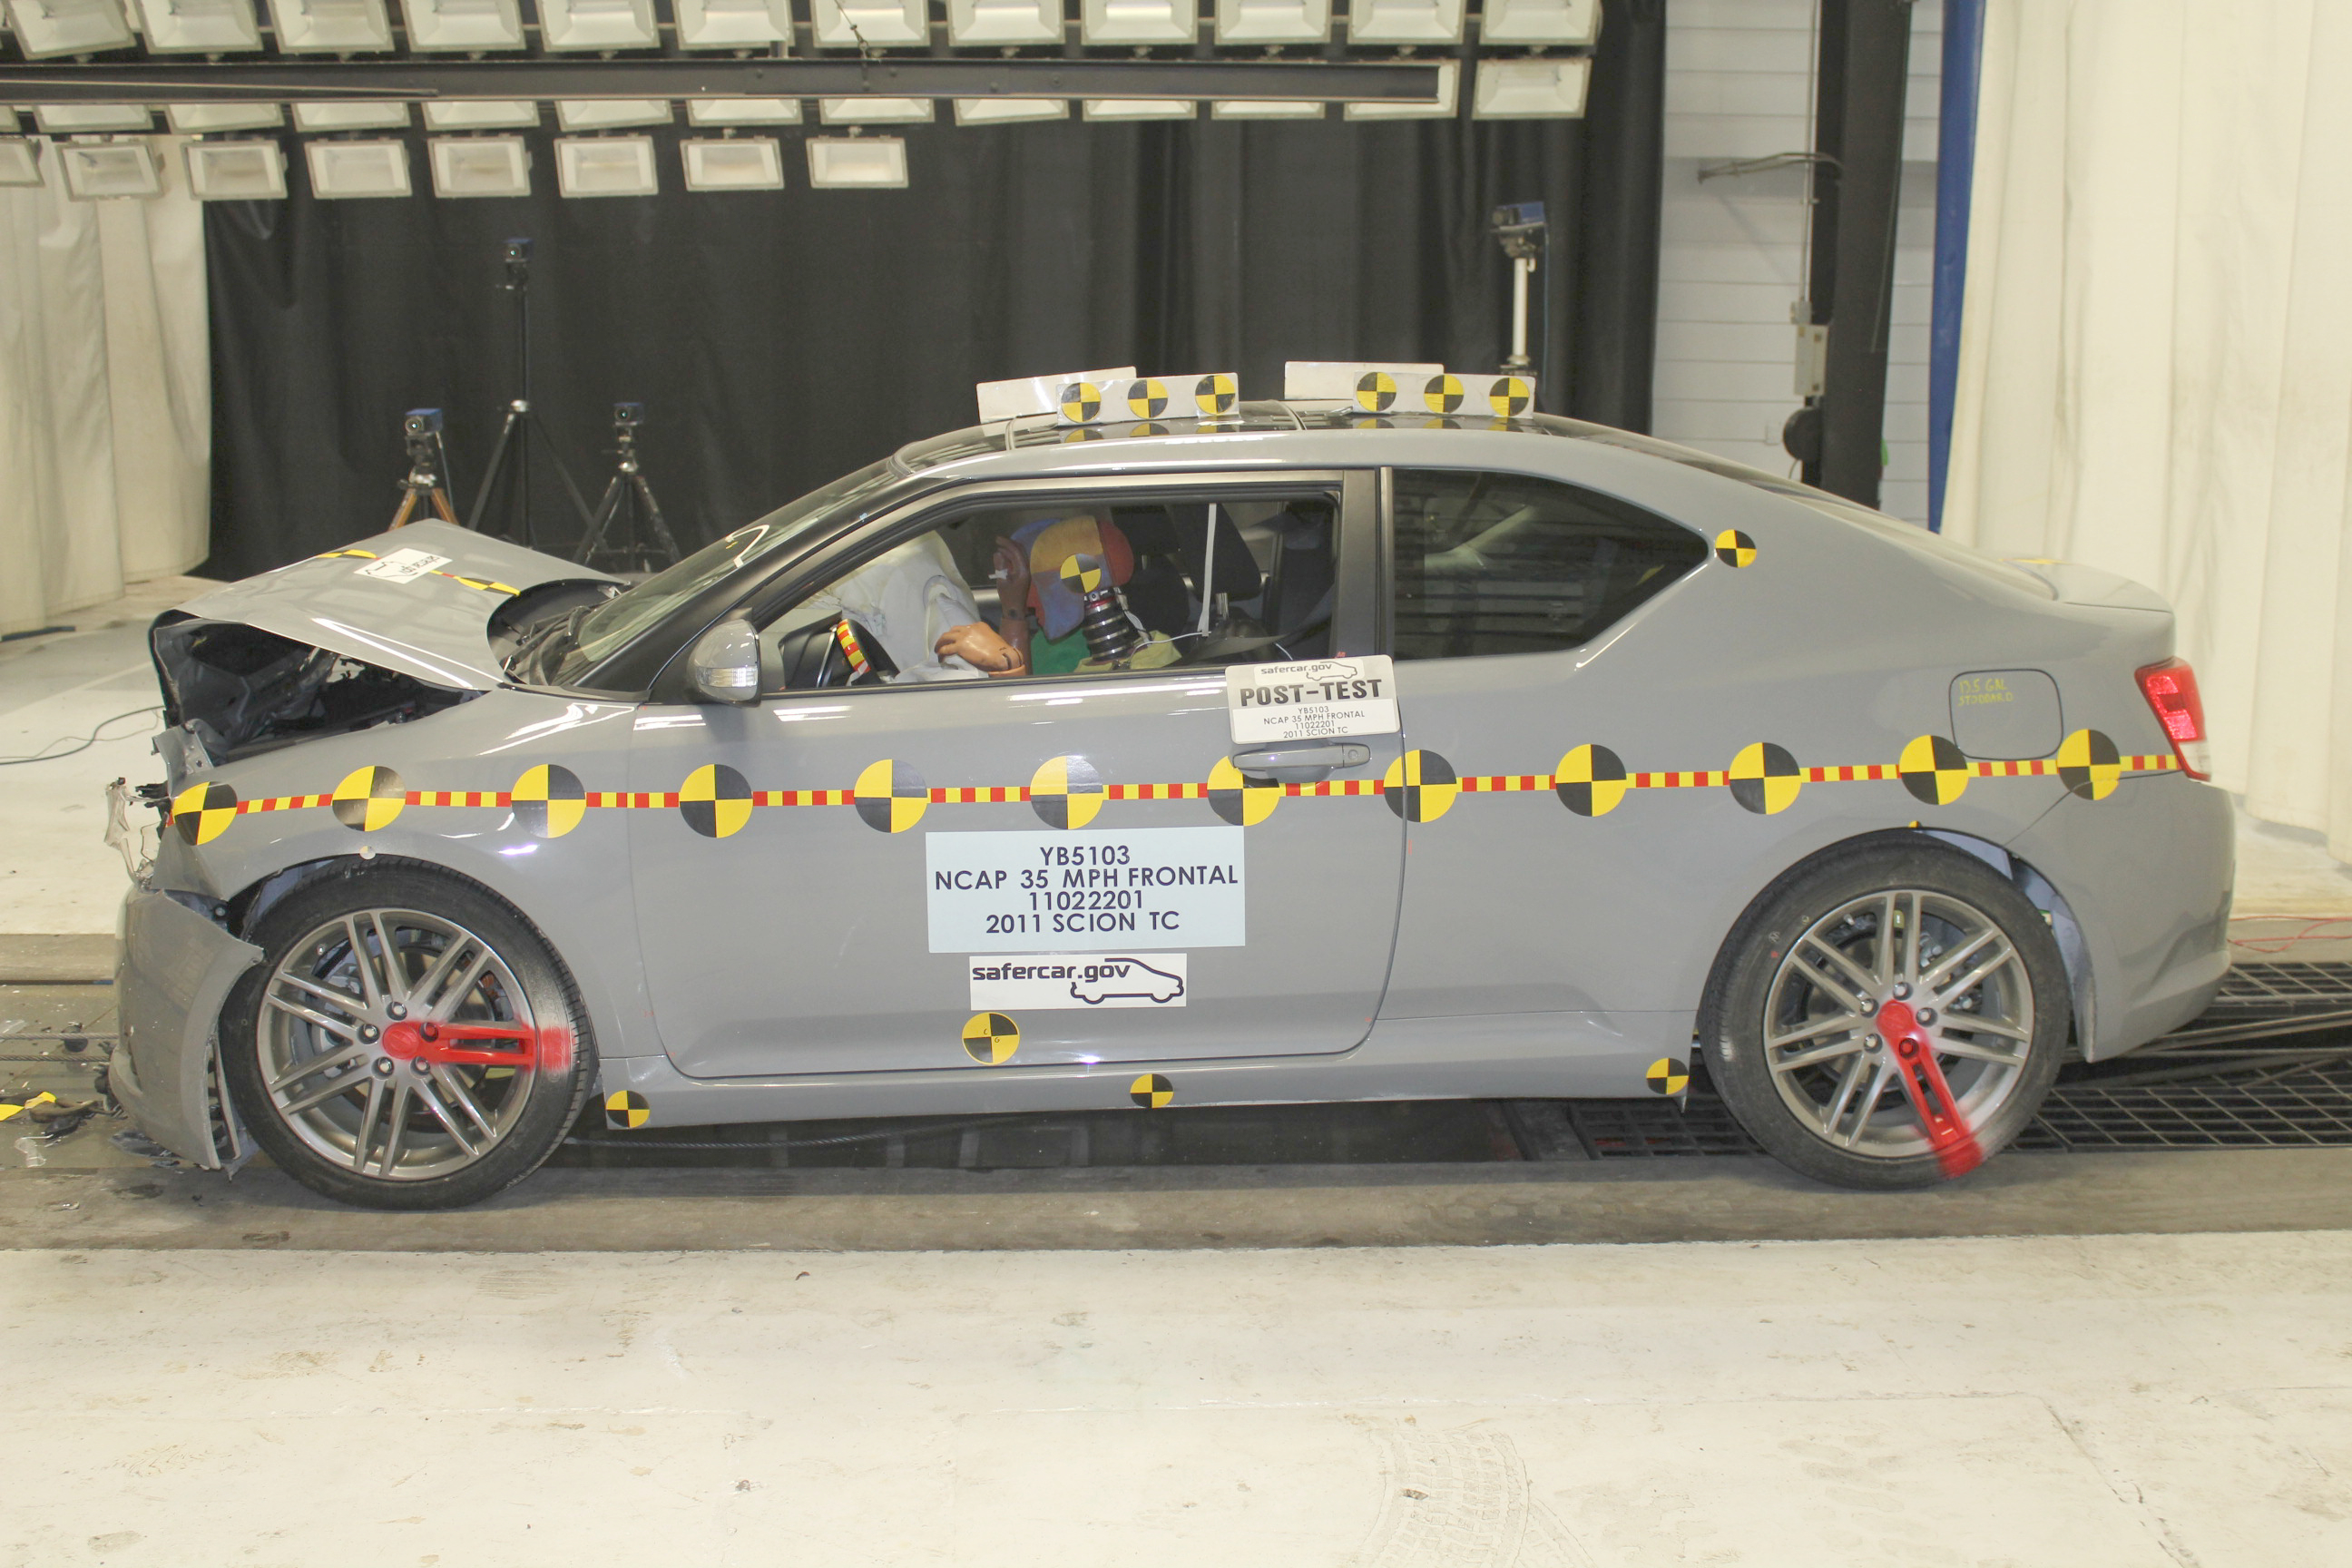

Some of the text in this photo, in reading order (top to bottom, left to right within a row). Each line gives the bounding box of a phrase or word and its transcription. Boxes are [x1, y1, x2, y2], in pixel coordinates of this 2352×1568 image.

[1260, 663, 1332, 675] safercar.gov
[1240, 679, 1382, 707] POST-TEST
[1263, 710, 1365, 725] NCAP 35 MPH FRONTAL
[1298, 706, 1329, 715] YB5103
[1283, 726, 1348, 739] 2011 SCION TC
[1295, 720, 1335, 730] 11022201
[1040, 845, 1131, 867] YB5103
[935, 865, 1239, 890] NCAP 35 MPH FRONTAL
[1029, 890, 1142, 911] 11022201
[985, 910, 1180, 934] 2011 SCION TC
[972, 963, 1131, 983] safercar.gov
